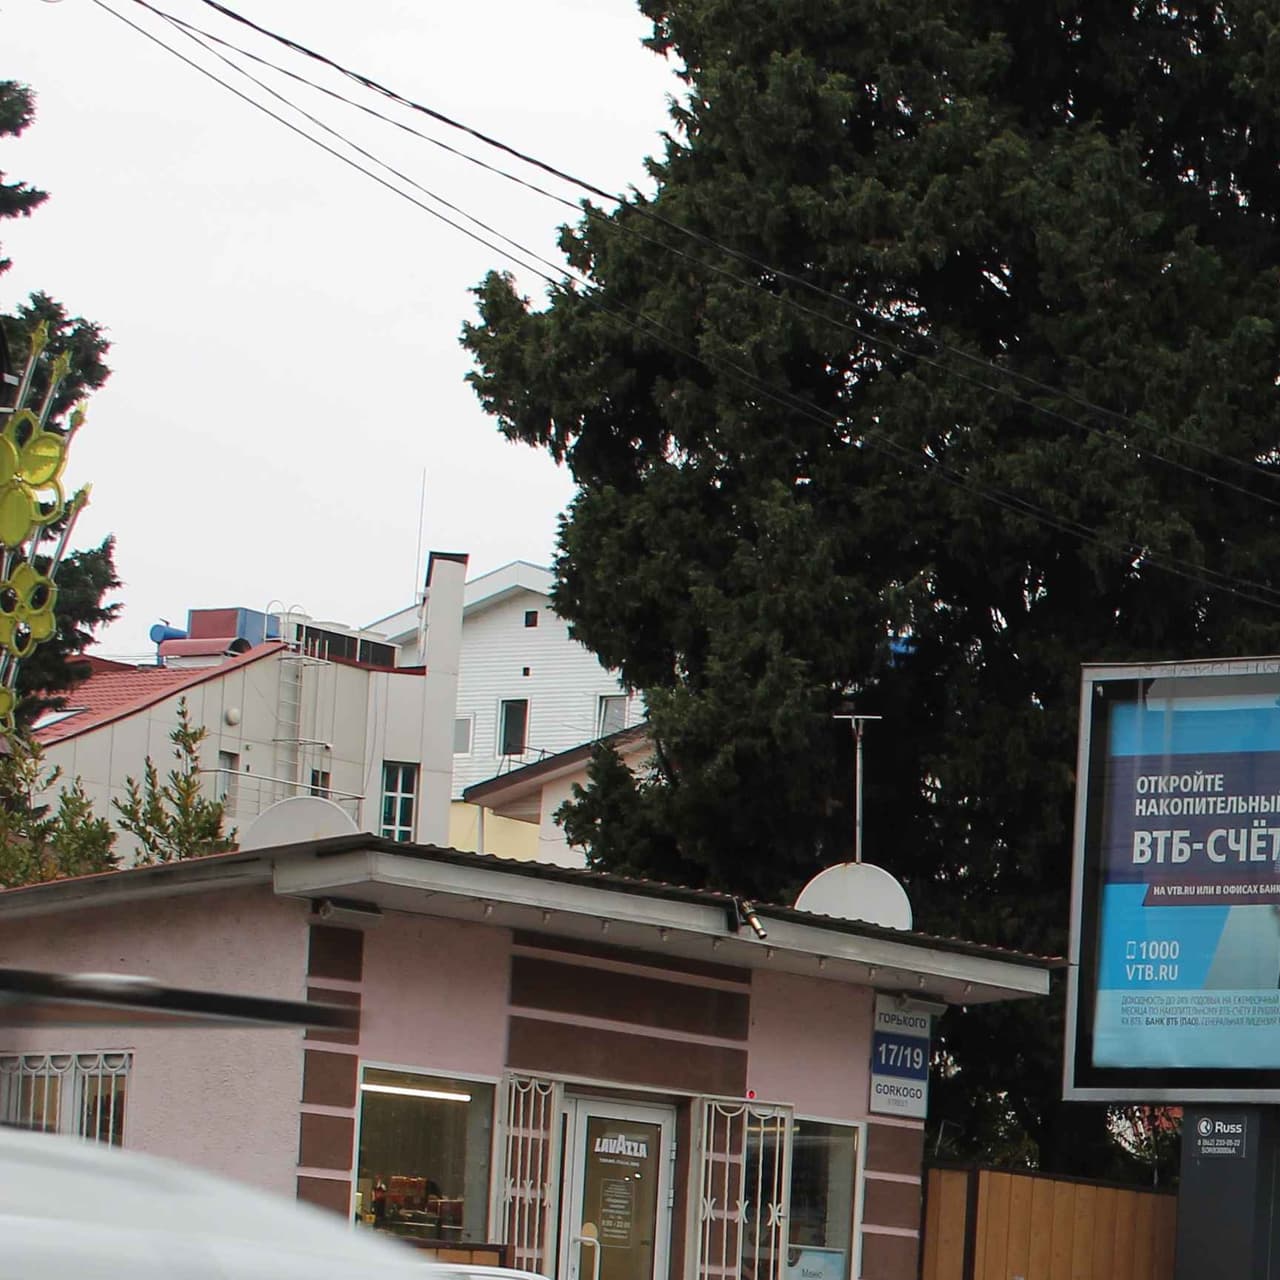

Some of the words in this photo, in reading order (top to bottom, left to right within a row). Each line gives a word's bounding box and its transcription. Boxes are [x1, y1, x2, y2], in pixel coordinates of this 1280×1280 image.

[1136, 770, 1224, 794] ОТКРОЙТЕ
[1153, 886, 1166, 896] НА
[1167, 886, 1196, 896] VTB.RU
[1196, 885, 1215, 895] ИЛИ
[1215, 885, 1222, 895] В
[1222, 883, 1259, 895] ОФИСАХ
[1139, 940, 1180, 960] 1000
[1126, 964, 1179, 981] VTB.RU
[879, 1013, 927, 1029] ГОРЬКОГО
[879, 1043, 924, 1070] 17/19
[875, 1083, 923, 1100] GORKOGO
[1215, 1121, 1242, 1134] Russ
[594, 1134, 648, 1159] LAVAZZA
